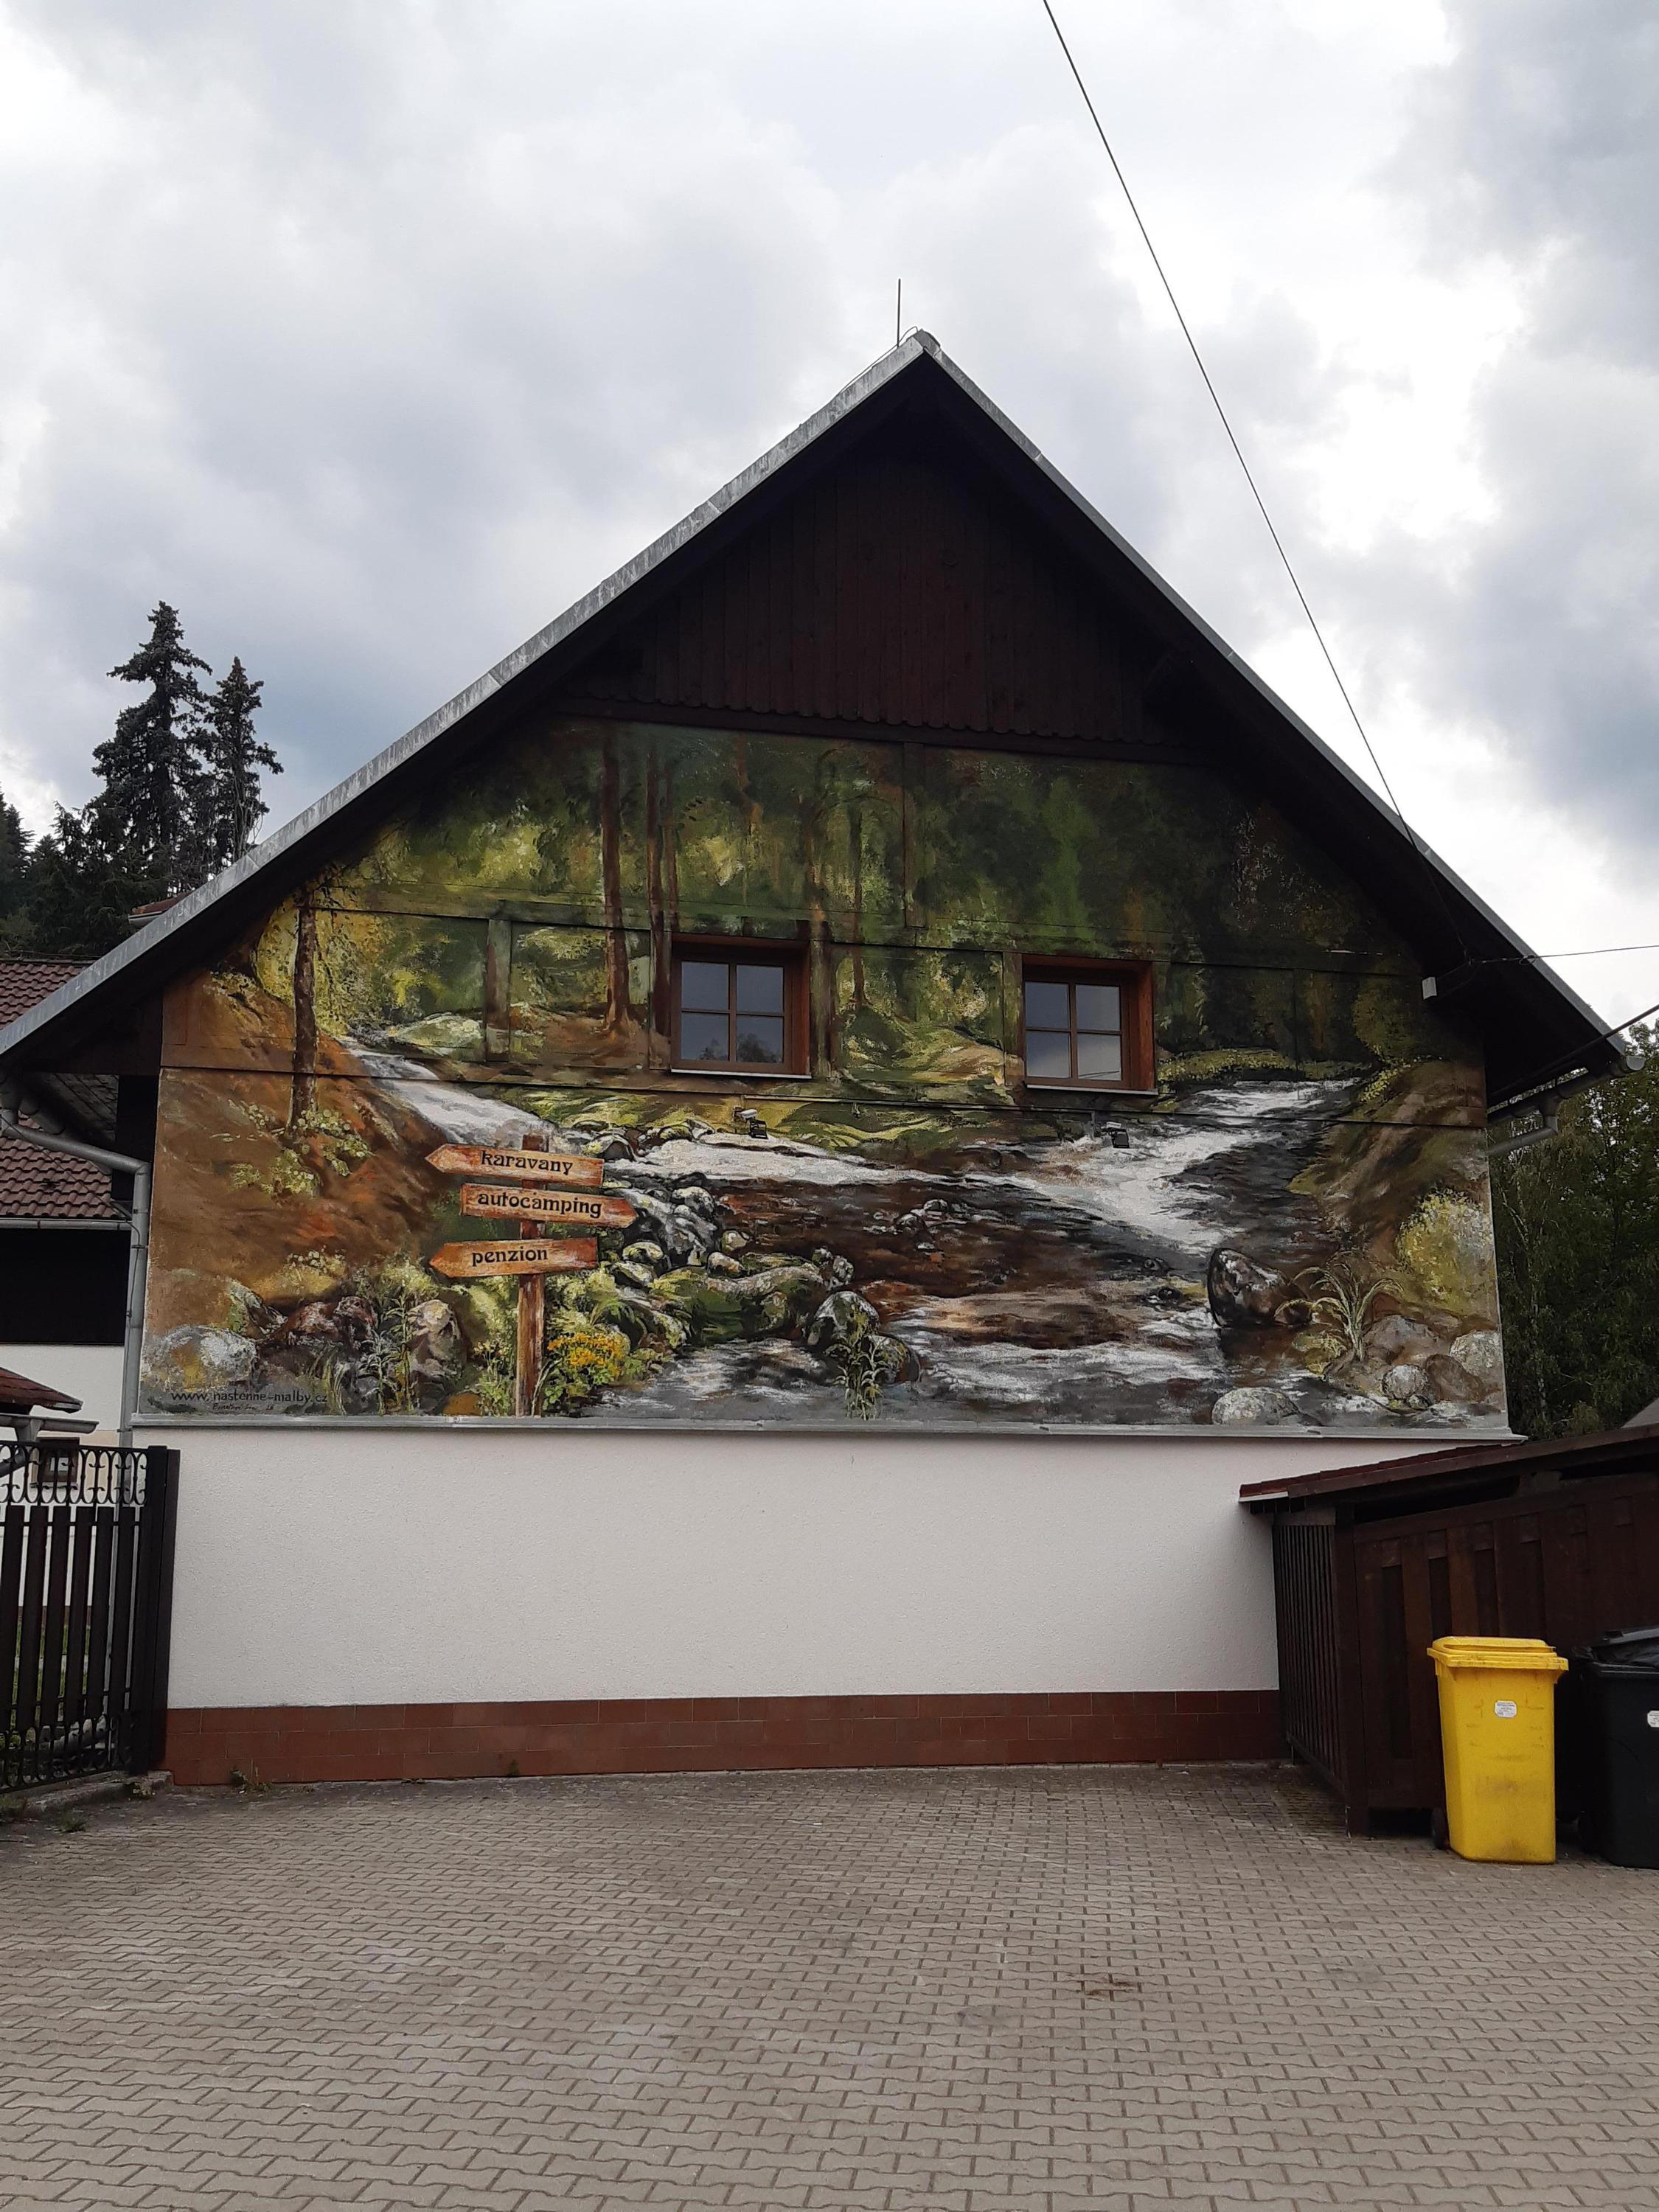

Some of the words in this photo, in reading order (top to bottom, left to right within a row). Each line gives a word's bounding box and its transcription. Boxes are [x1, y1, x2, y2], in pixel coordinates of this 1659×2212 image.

[481, 1150, 573, 1175] karavany
[478, 1192, 602, 1218] autocamping
[472, 1246, 548, 1267] penzion
